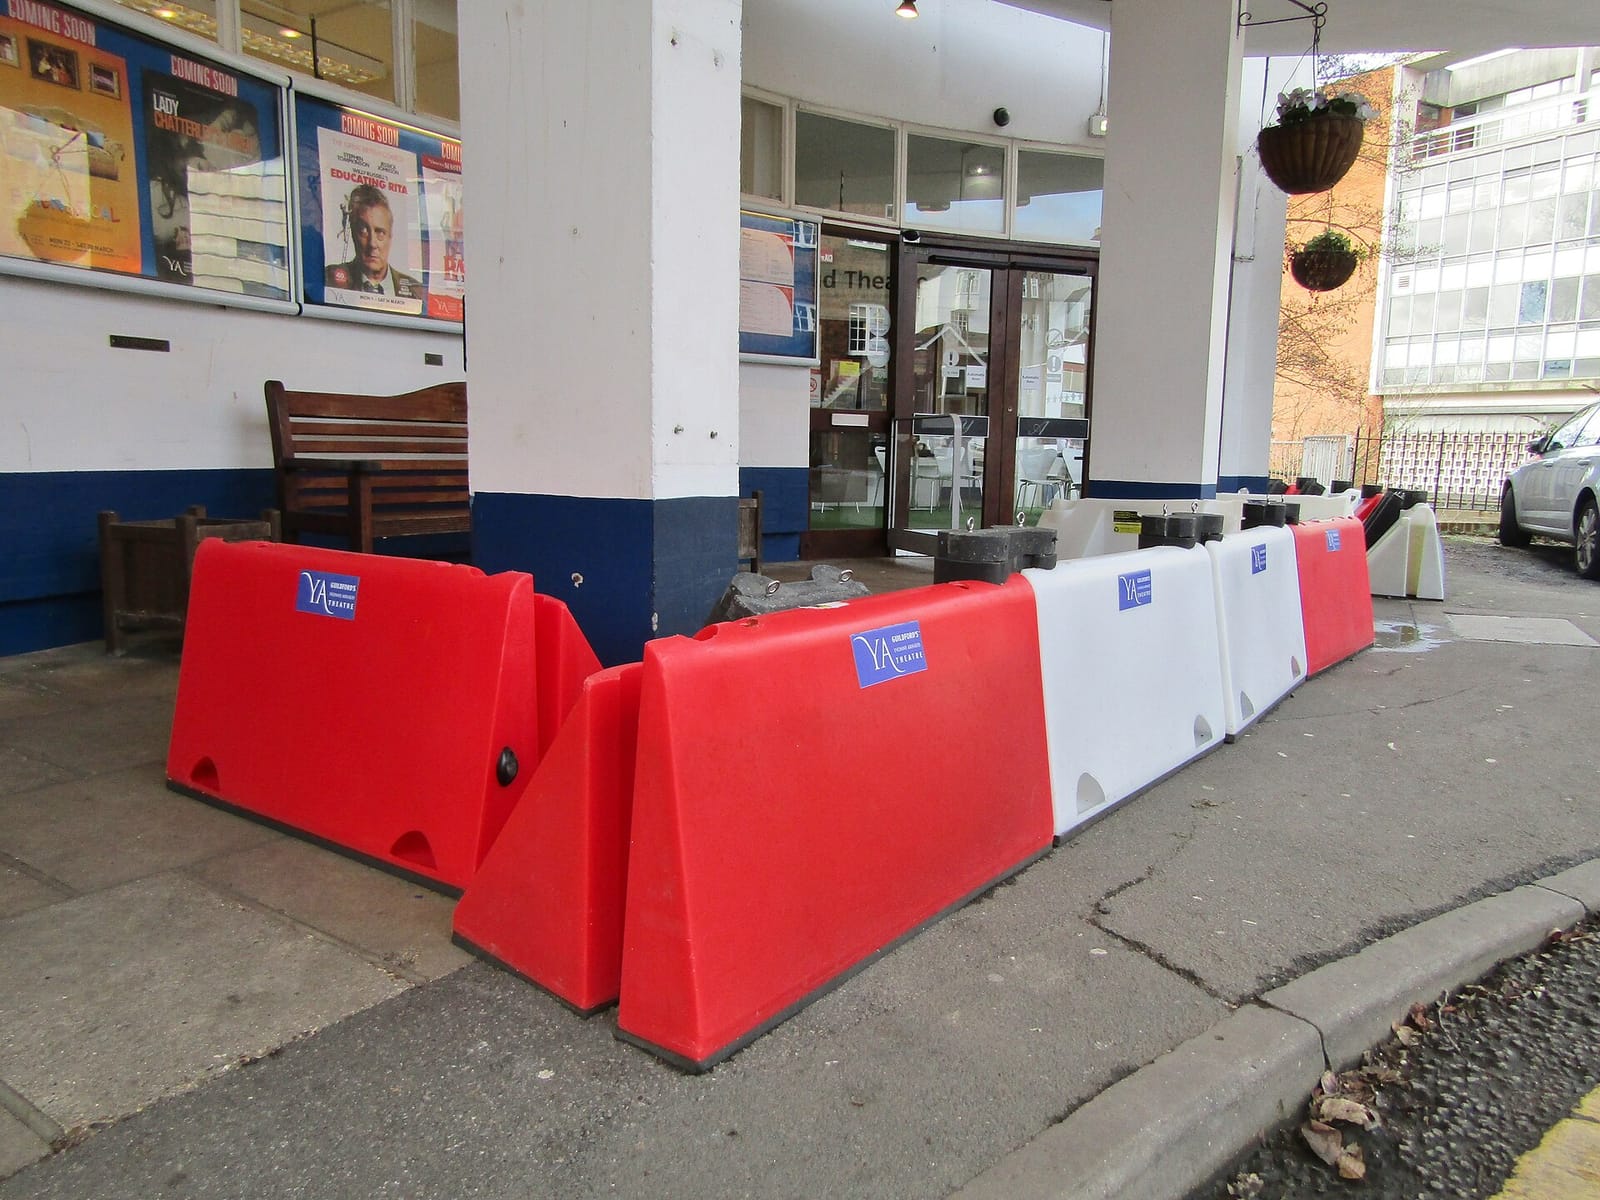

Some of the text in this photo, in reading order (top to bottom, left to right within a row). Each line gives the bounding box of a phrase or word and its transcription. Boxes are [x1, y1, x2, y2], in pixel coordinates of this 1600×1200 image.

[8, 0, 96, 47] COMING SOON
[170, 55, 238, 97] COMING SOON
[153, 93, 179, 116] LADY
[341, 115, 399, 147] COMING SOON
[330, 168, 408, 195] EDUCATING RITA
[301, 572, 334, 614] YA
[328, 599, 355, 610] THEATRE
[1119, 576, 1142, 605] YA
[853, 636, 906, 673] YA
[895, 651, 923, 664] THEATRE
